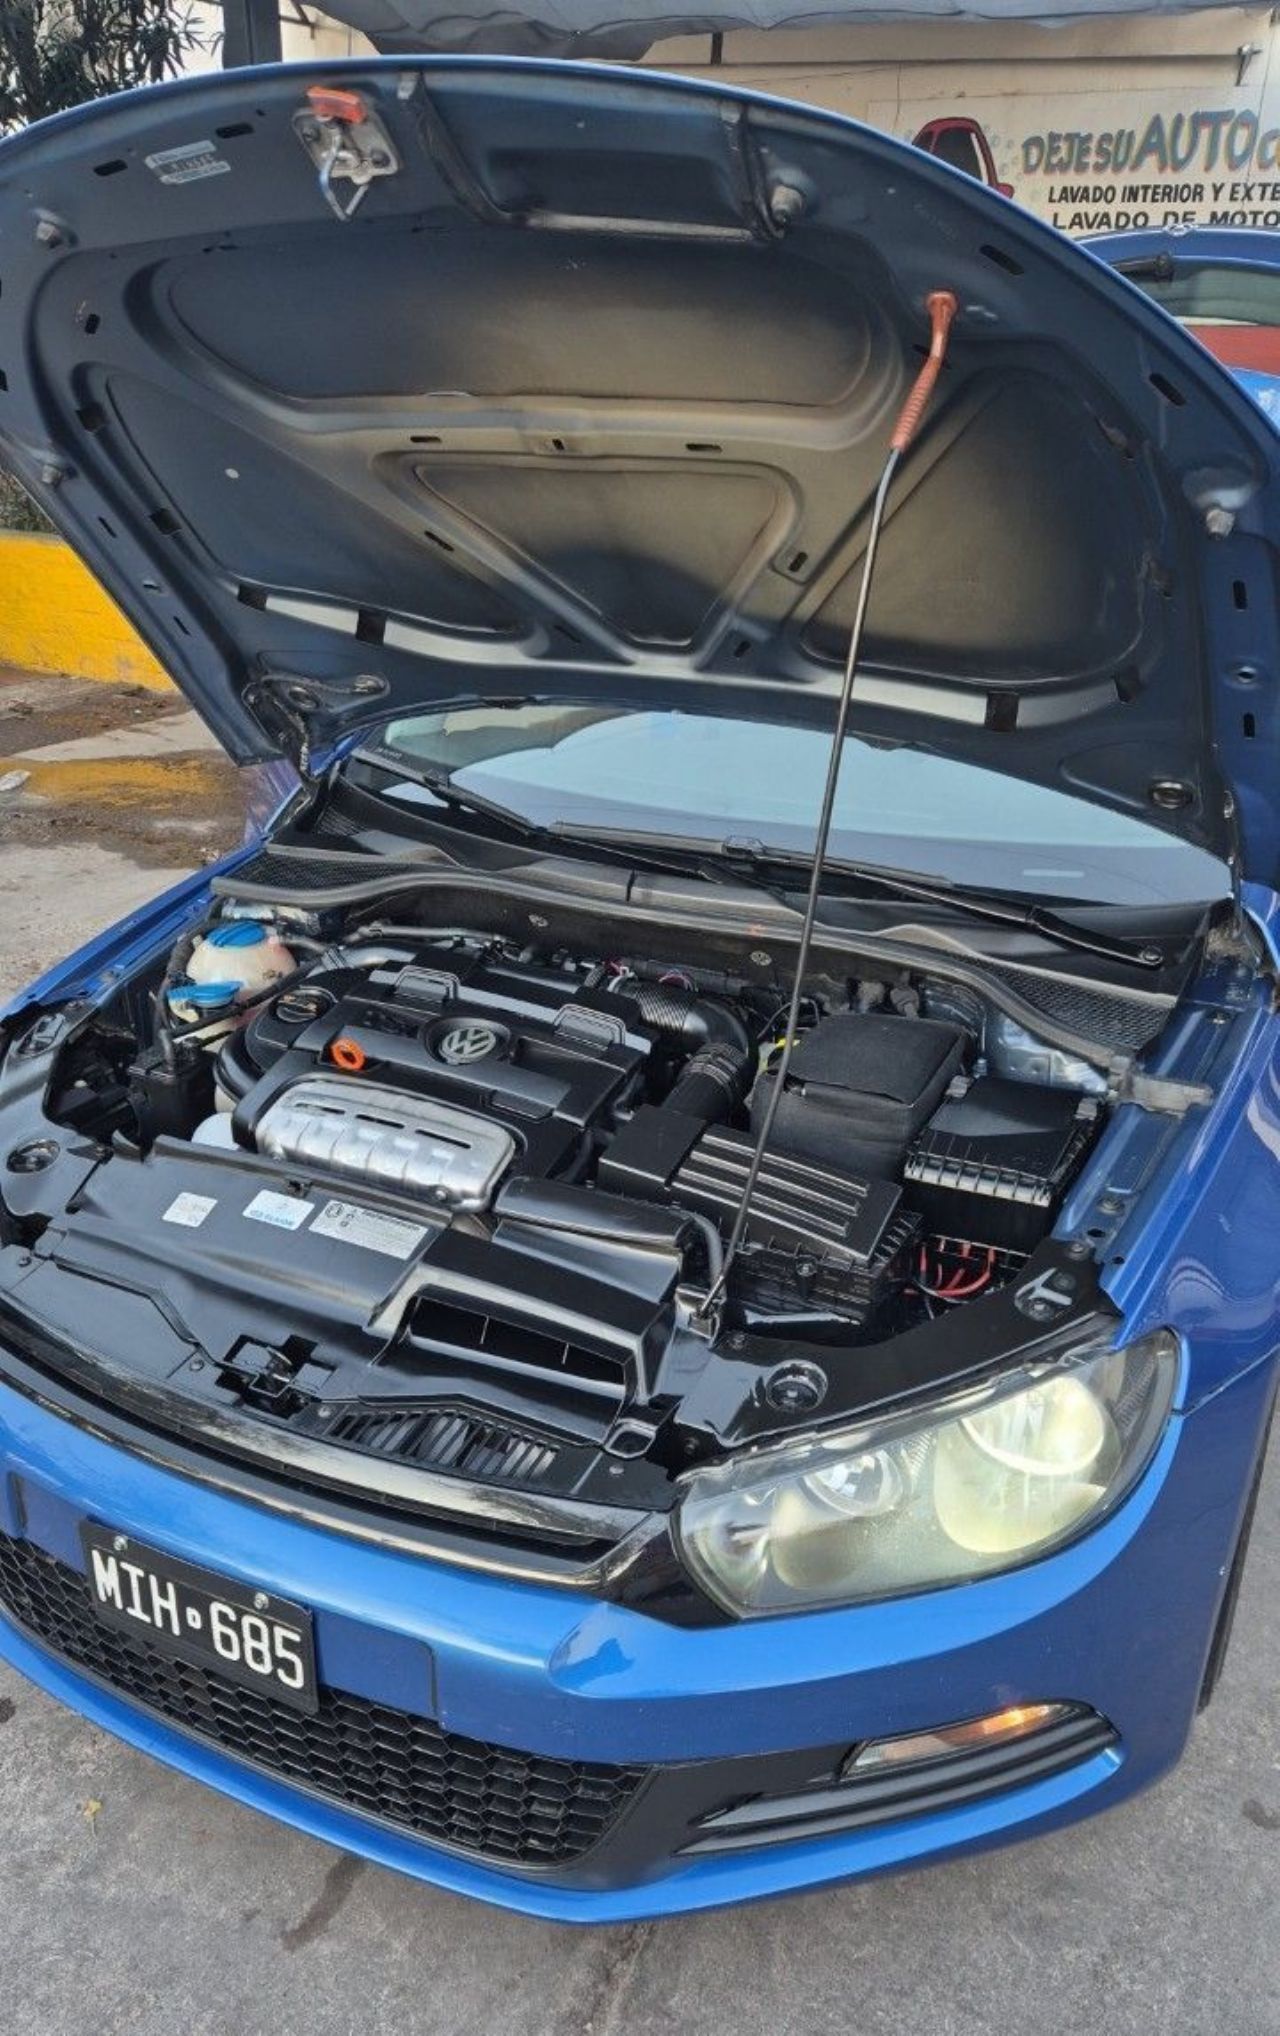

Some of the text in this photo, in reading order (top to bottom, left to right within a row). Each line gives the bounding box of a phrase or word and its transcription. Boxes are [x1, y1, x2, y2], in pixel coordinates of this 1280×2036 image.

[1128, 109, 1259, 173] AUTO
[1048, 185, 1116, 204] LAVADO
[1121, 183, 1204, 203] INTERIOR
[1212, 182, 1225, 202] Y
[1052, 210, 1280, 230] LAVADO DE MOTO
[91, 1549, 304, 1690] MIH 685
